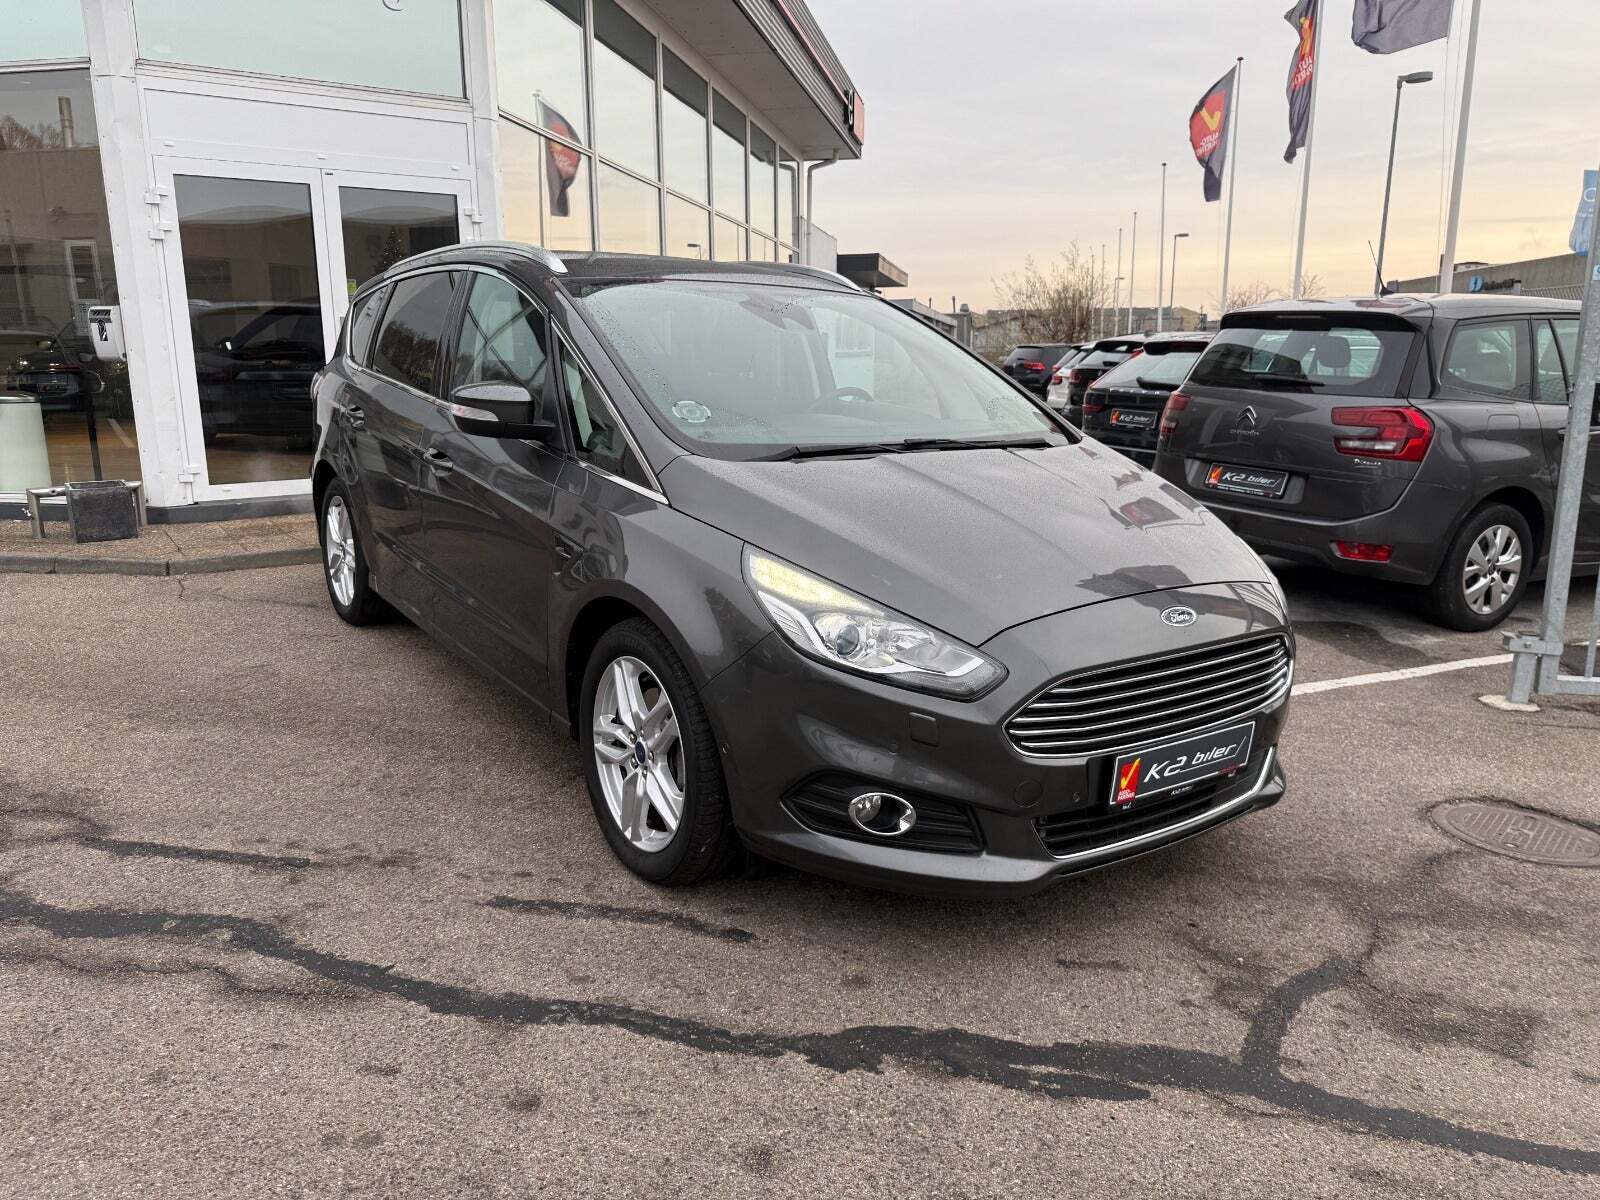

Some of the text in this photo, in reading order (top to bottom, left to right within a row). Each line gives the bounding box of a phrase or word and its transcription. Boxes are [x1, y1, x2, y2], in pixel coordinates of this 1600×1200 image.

[1222, 471, 1246, 482] K2
[1247, 475, 1275, 485] biler
[1143, 743, 1237, 783] K2 biler
